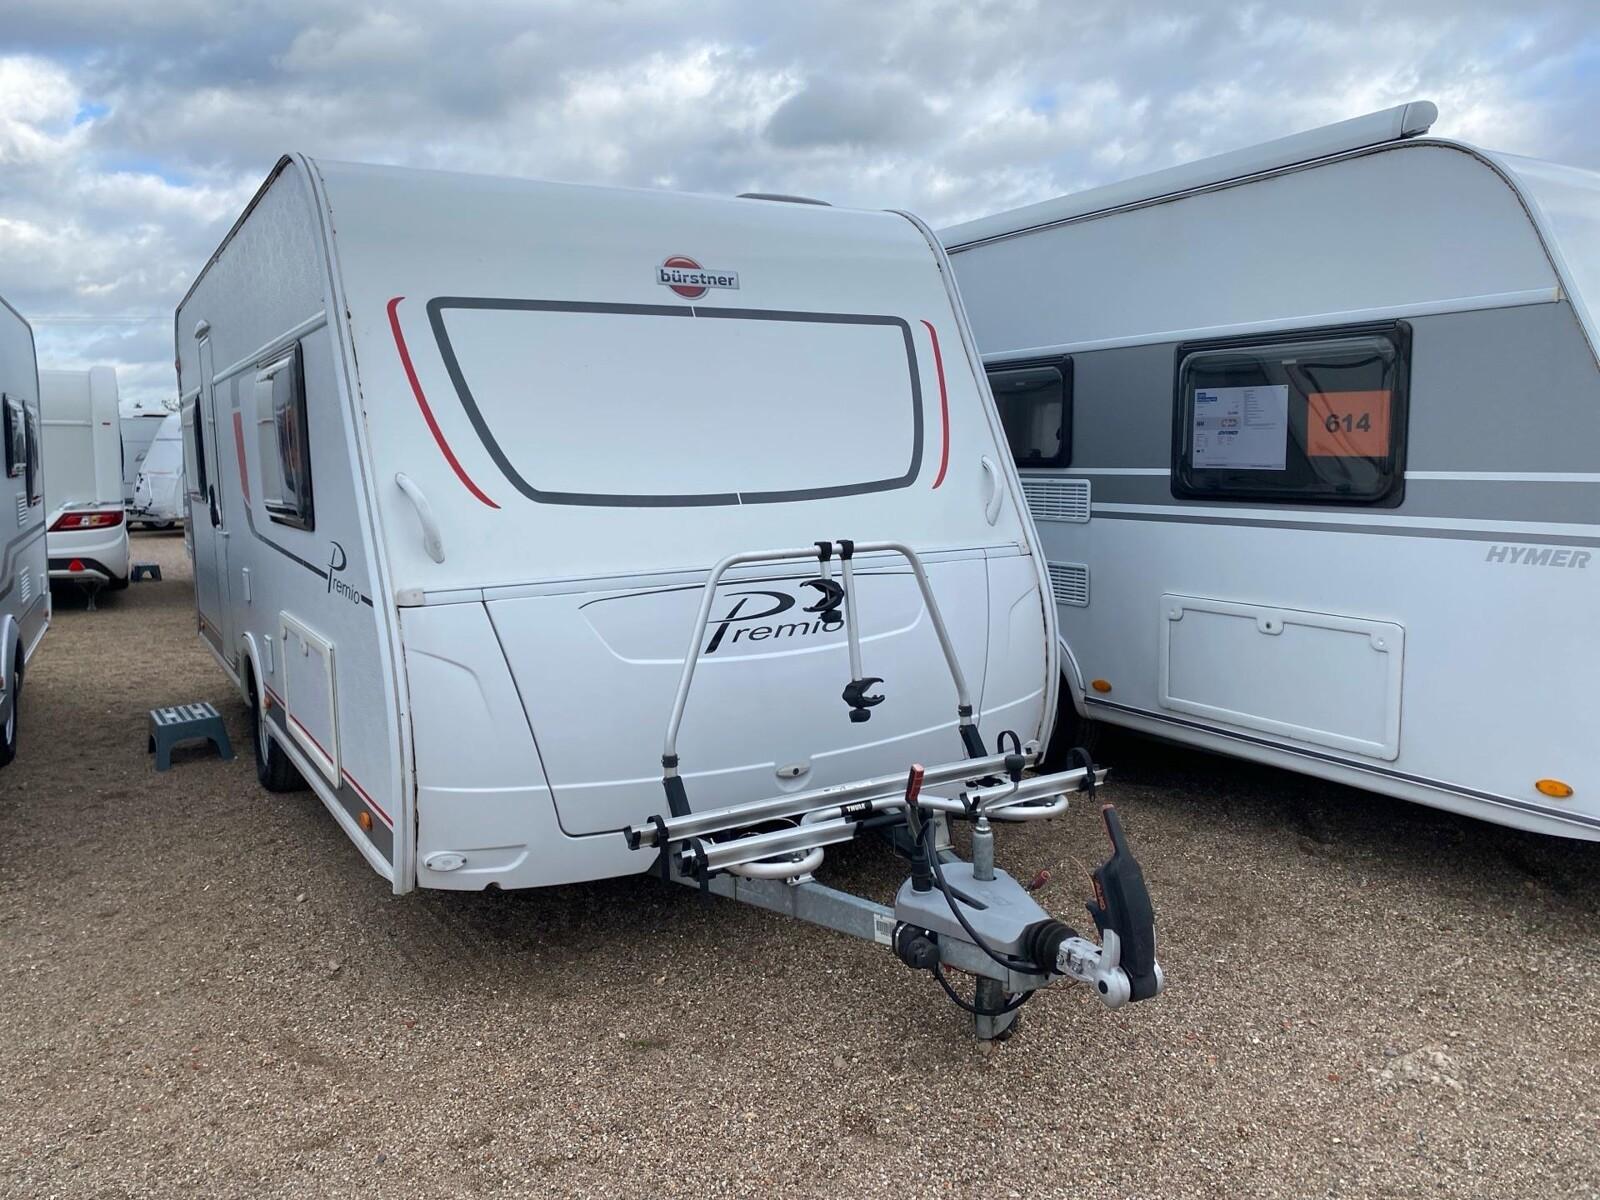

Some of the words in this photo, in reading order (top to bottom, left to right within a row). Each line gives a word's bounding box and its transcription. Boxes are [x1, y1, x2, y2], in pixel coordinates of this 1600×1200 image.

[660, 269, 735, 286] bürstner
[1325, 412, 1371, 434] 614
[1485, 545, 1592, 569] HYMER
[327, 540, 360, 605] Premio
[704, 590, 845, 655] Premio
